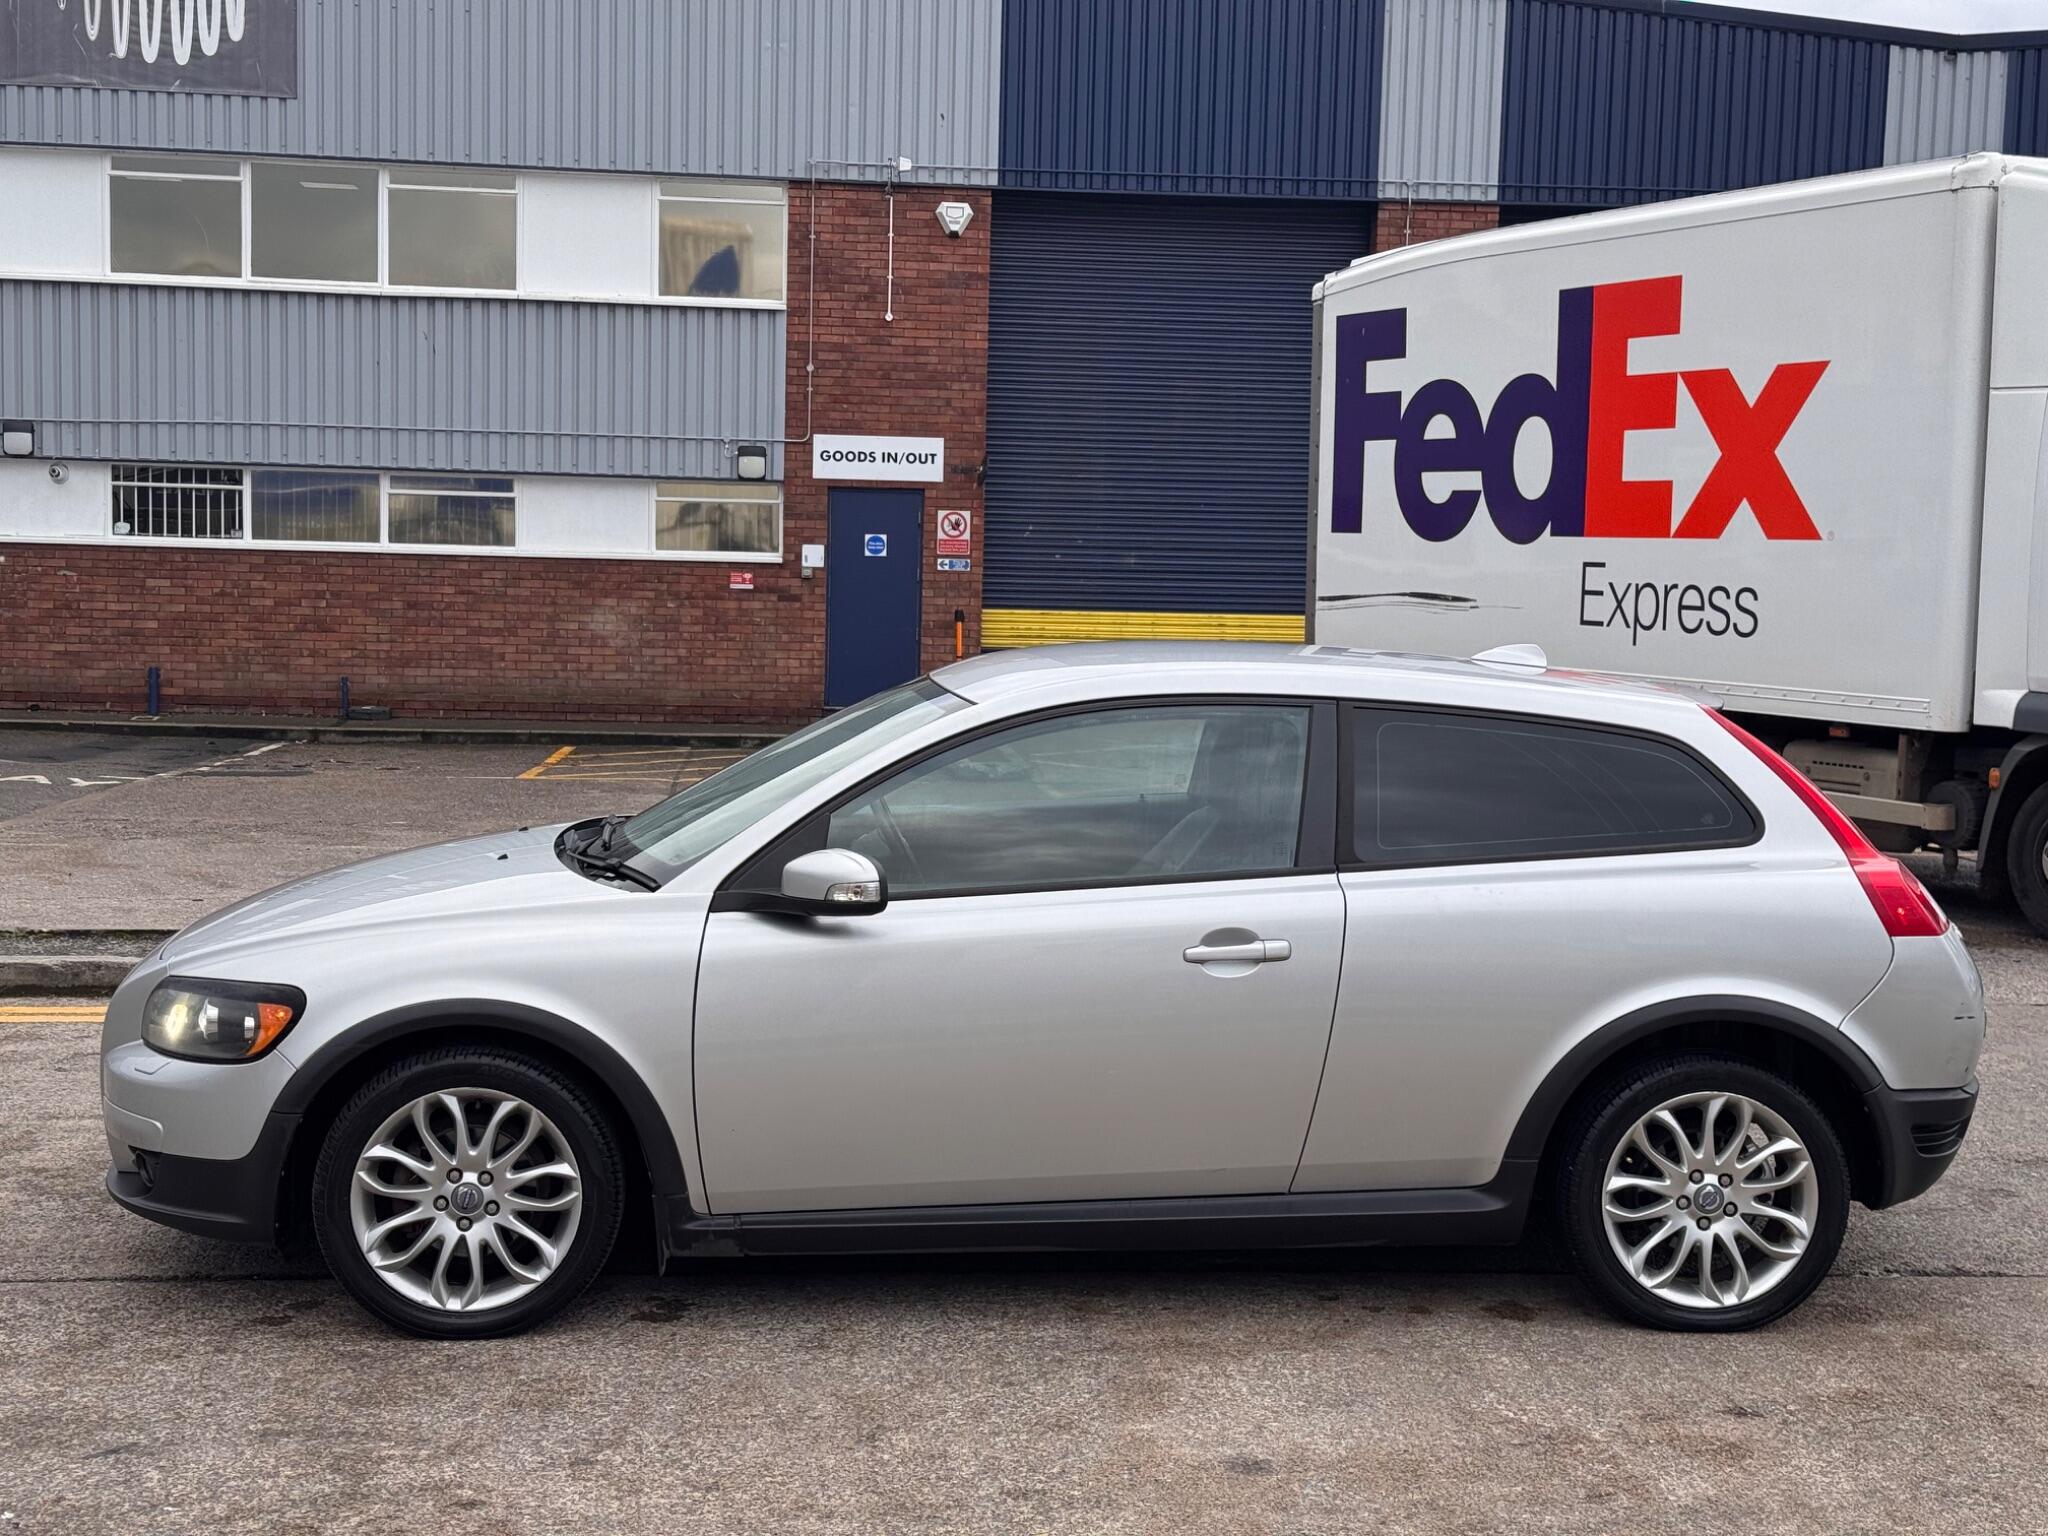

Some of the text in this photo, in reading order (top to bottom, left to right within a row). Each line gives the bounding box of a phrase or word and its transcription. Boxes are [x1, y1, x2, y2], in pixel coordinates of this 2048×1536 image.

[1331, 275, 1831, 545] FedEx
[820, 450, 937, 465] GOODS IN/OUT
[1580, 562, 1760, 645] Express
